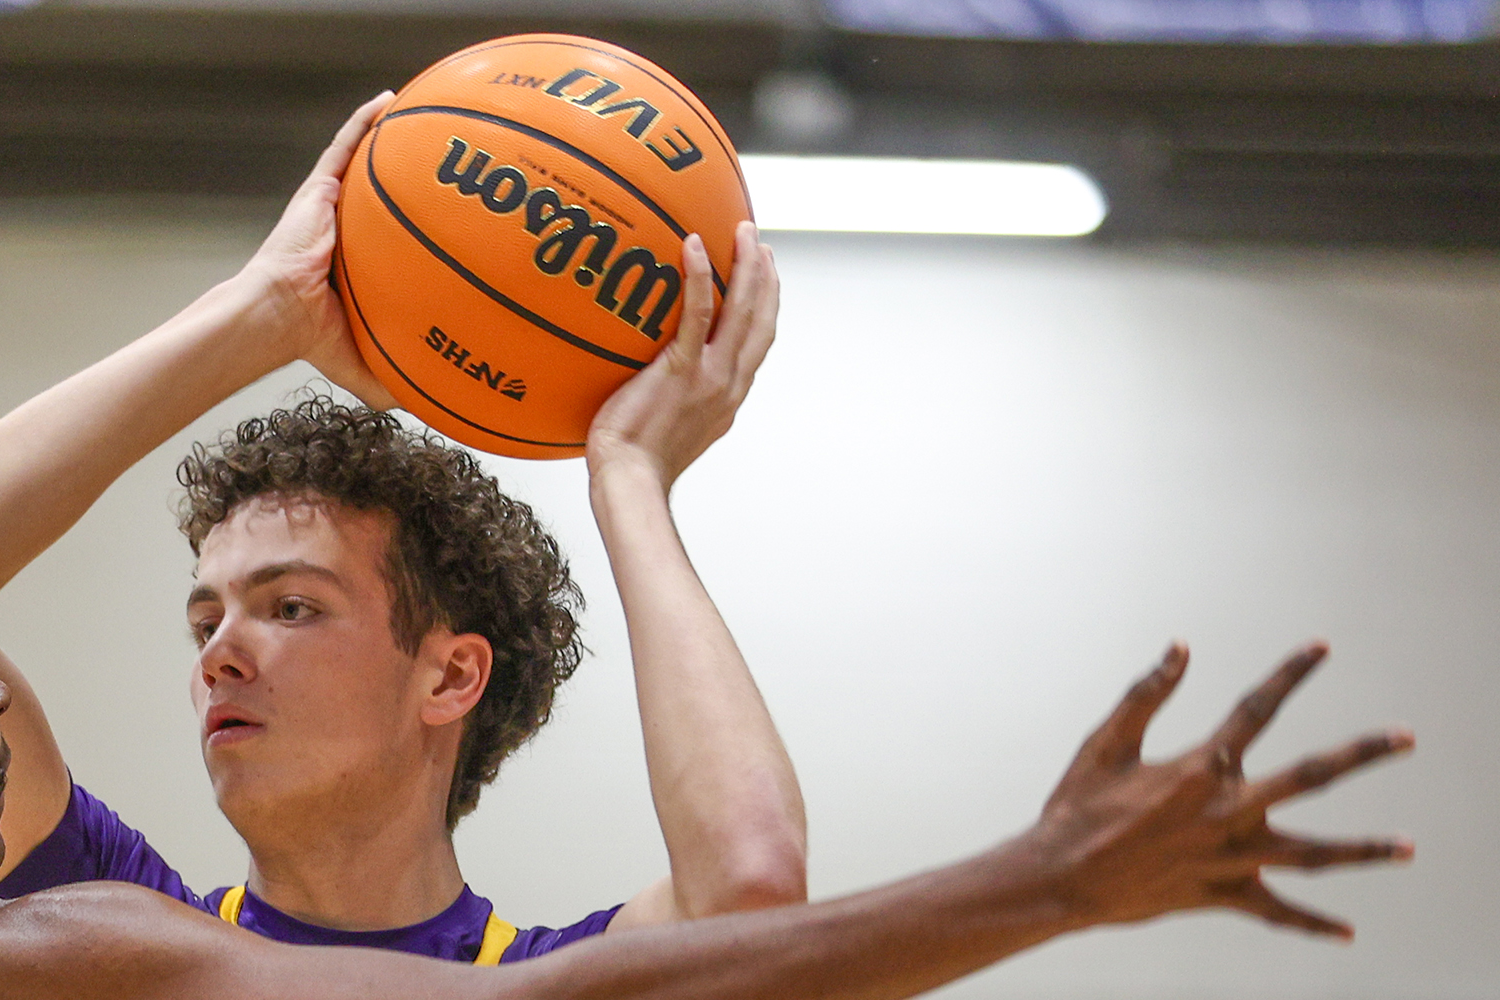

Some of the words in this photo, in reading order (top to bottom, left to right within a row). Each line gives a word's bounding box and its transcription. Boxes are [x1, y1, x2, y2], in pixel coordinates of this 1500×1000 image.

[488, 72, 547, 90] NXT
[541, 67, 706, 172] EVO
[435, 135, 682, 342] Wilson
[425, 325, 507, 391] NFHS
